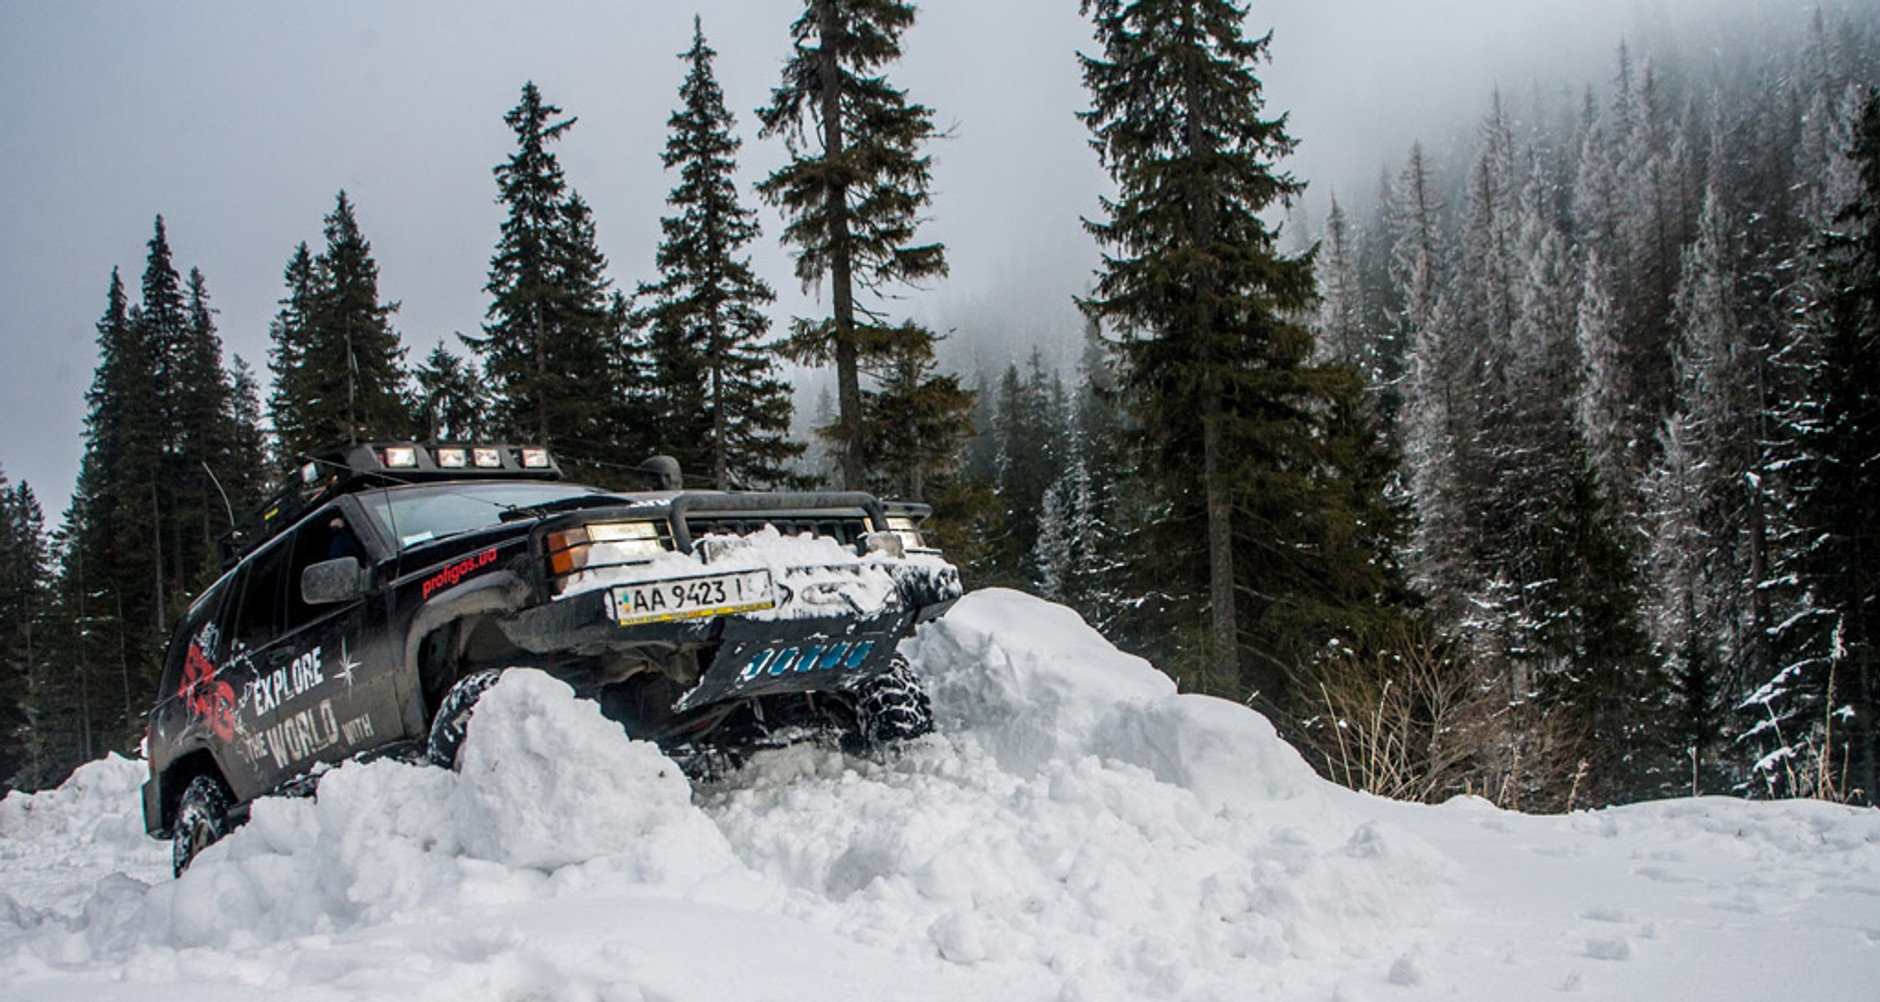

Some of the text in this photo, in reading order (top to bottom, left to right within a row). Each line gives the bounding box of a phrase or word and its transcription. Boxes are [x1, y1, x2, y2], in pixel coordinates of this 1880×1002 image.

[422, 547, 497, 600] profigas.ua
[633, 589, 666, 613] AA
[672, 581, 726, 608] 9423
[253, 646, 324, 717] EXPLORE
[246, 698, 374, 769] THE WORLD WITH
